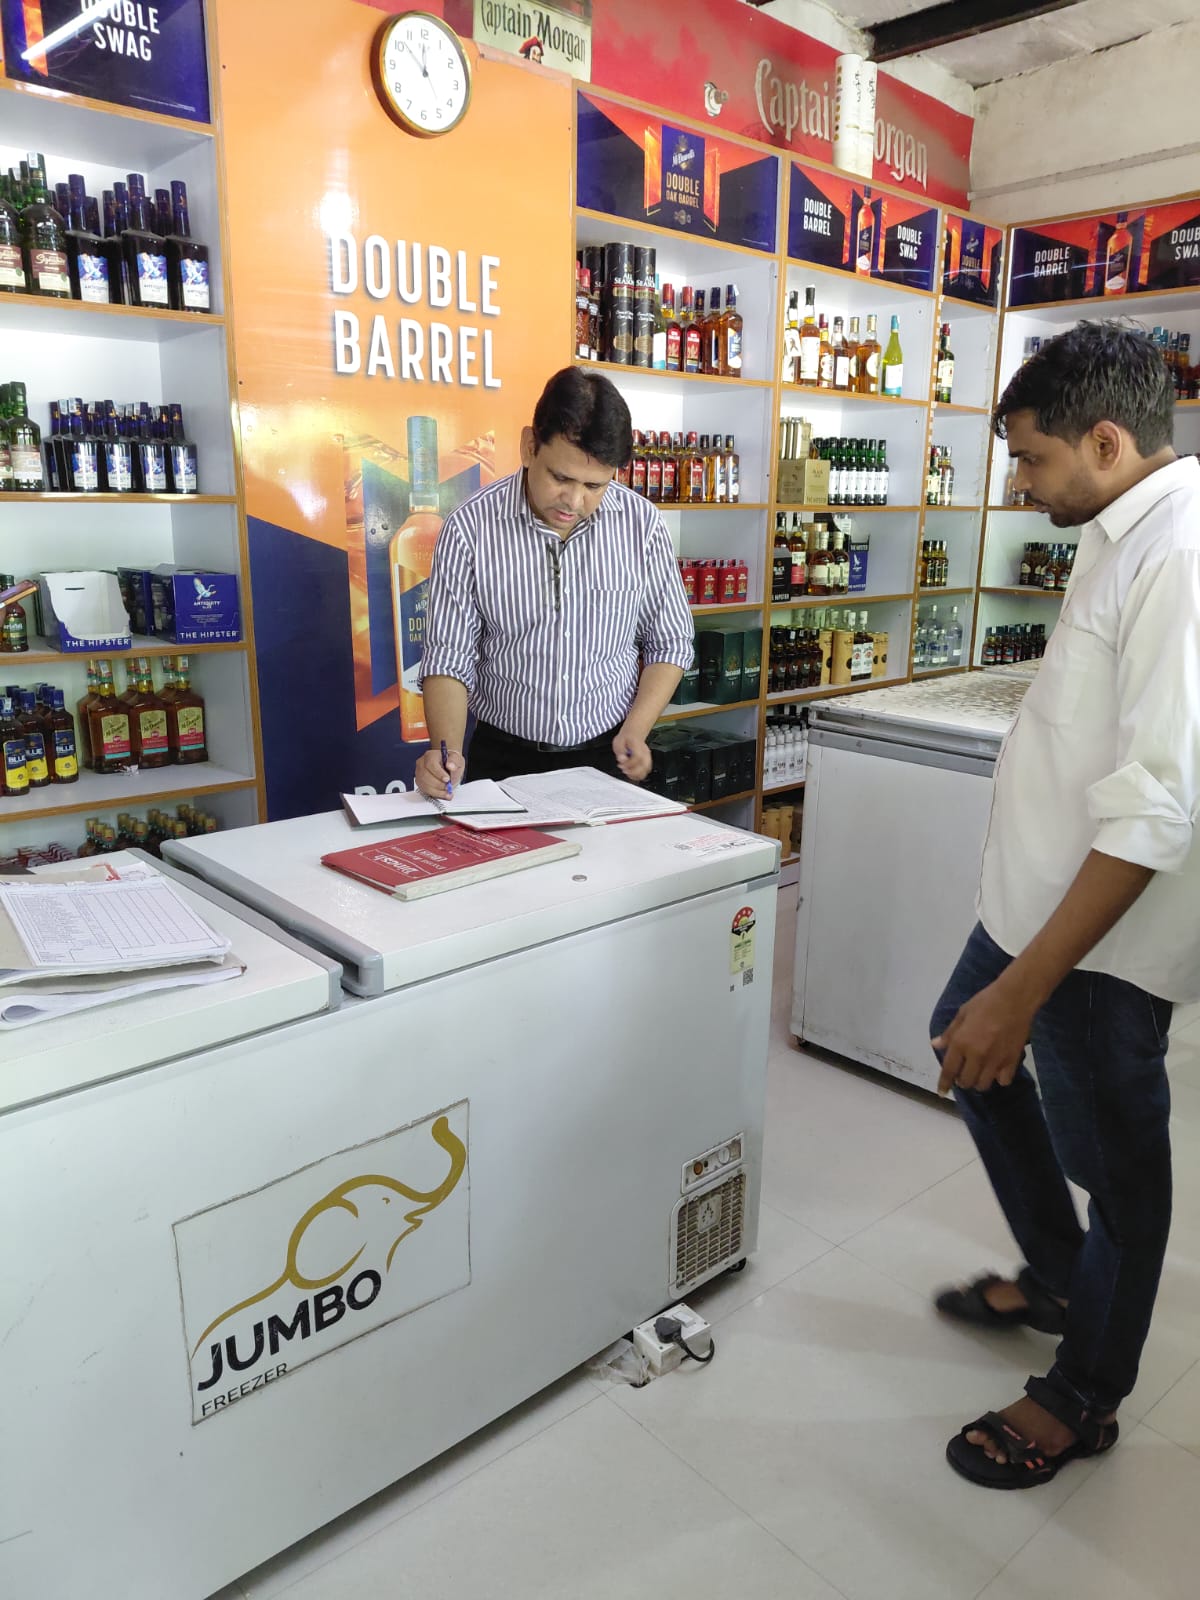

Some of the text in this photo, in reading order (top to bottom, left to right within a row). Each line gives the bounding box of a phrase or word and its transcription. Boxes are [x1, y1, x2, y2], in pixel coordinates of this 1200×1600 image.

[93, 22, 152, 61] SWAG
[406, 29, 413, 41] 11
[420, 28, 429, 40] 12
[533, 10, 586, 64] Morgan
[394, 40, 404, 52] 10
[438, 40, 442, 50] 1
[390, 59, 396, 70] 9
[447, 58, 454, 68] 2
[395, 83, 401, 93] 8
[453, 80, 460, 90] 3
[406, 99, 412, 111] 7
[446, 98, 453, 108] 4
[421, 109, 427, 121] 6
[436, 108, 442, 119] 5
[754, 58, 929, 192] Captai organ
[666, 171, 700, 196] DOUBLE
[666, 190, 700, 209] OAK BARREL
[803, 197, 833, 220] DOUBLE
[803, 214, 832, 237] BARREL
[897, 225, 923, 246] DOUBLE
[899, 243, 919, 261] SWAG
[1034, 247, 1071, 264] DOUBLE
[331, 232, 501, 316] DOUBLE
[1033, 262, 1069, 278] BARREL
[334, 309, 502, 388] BARREL
[179, 630, 237, 639] THE HIPSTER
[65, 638, 129, 648] THE HIPSTER
[197, 1269, 382, 1391] JUMBO
[201, 1362, 288, 1417] FREEZER
